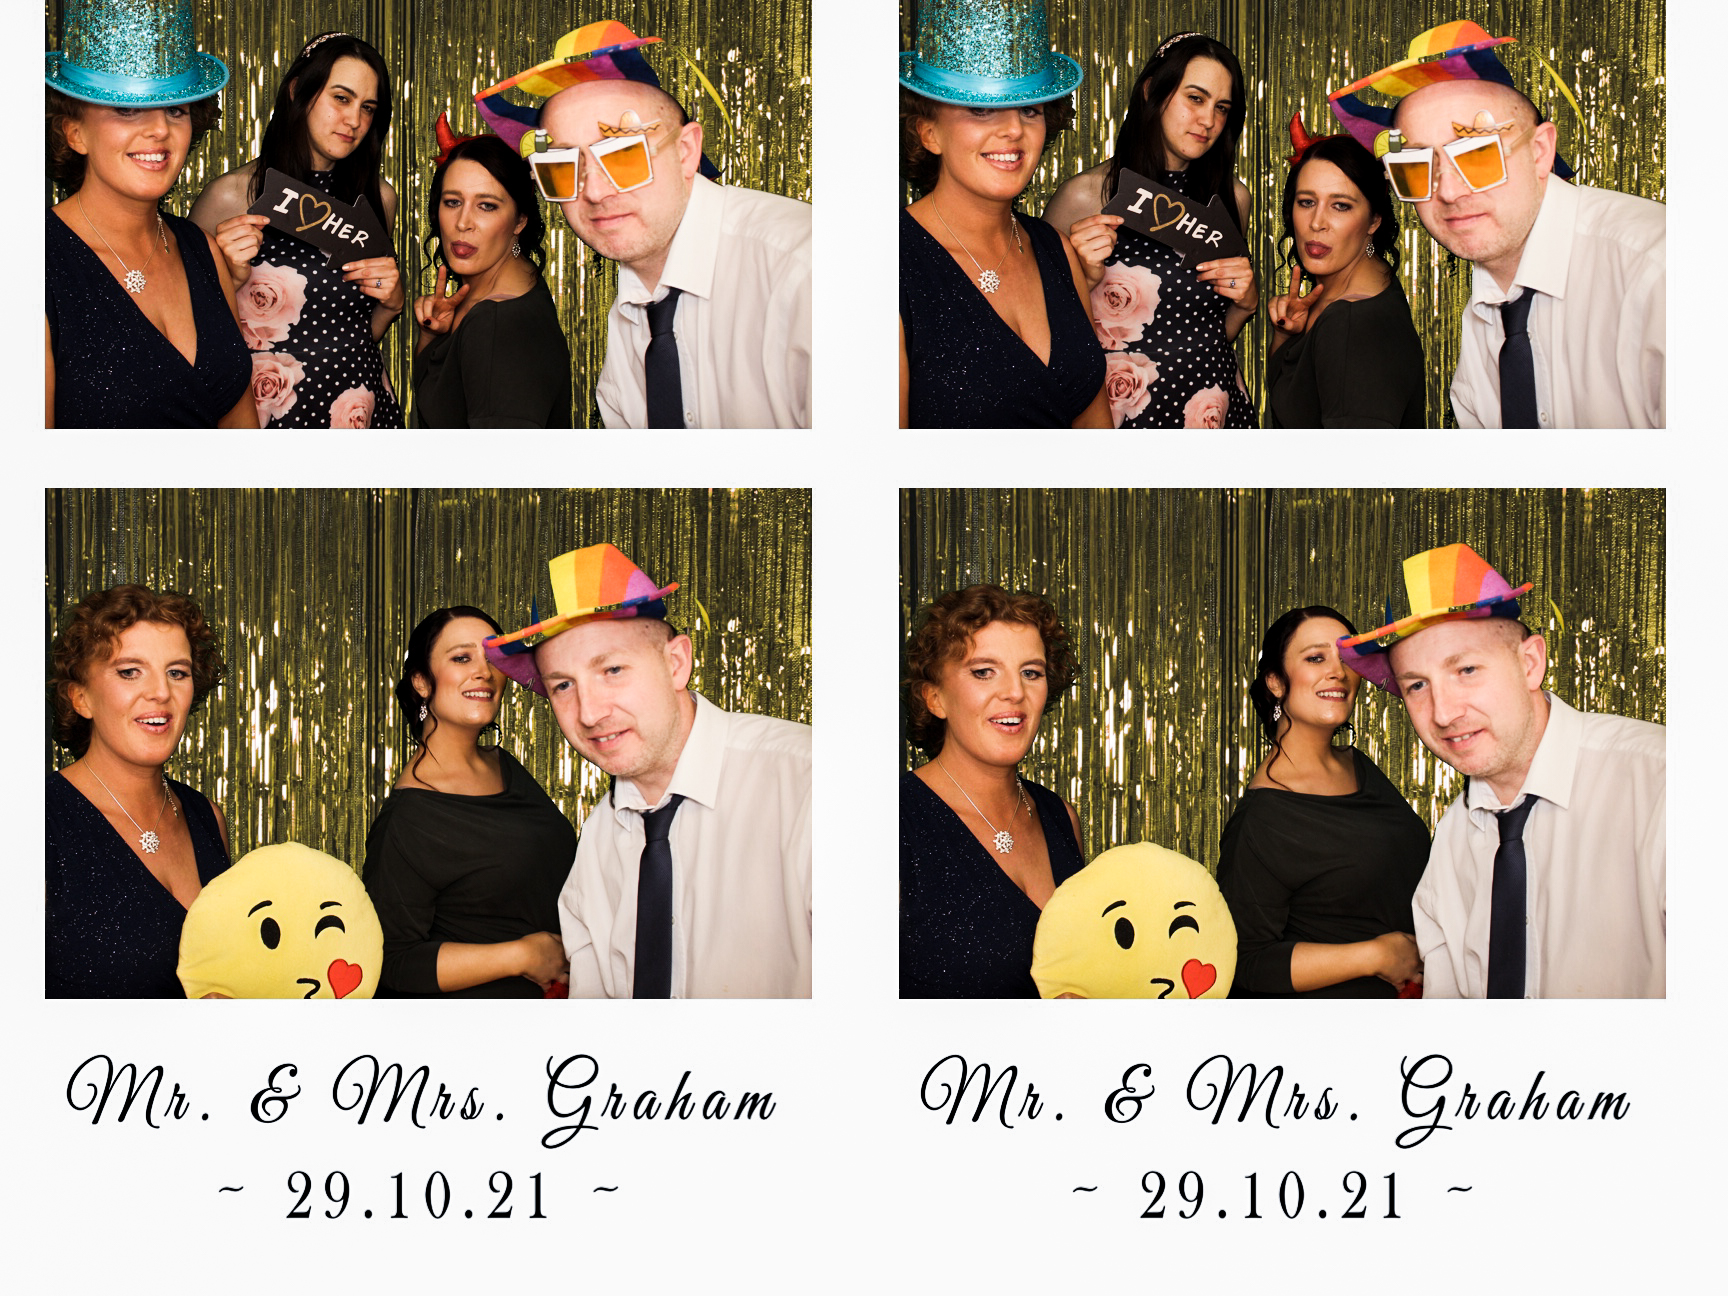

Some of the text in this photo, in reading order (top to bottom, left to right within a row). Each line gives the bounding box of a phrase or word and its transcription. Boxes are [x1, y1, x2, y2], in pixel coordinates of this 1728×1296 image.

[272, 187, 370, 248] I HER
[1126, 187, 1224, 248] I HER
